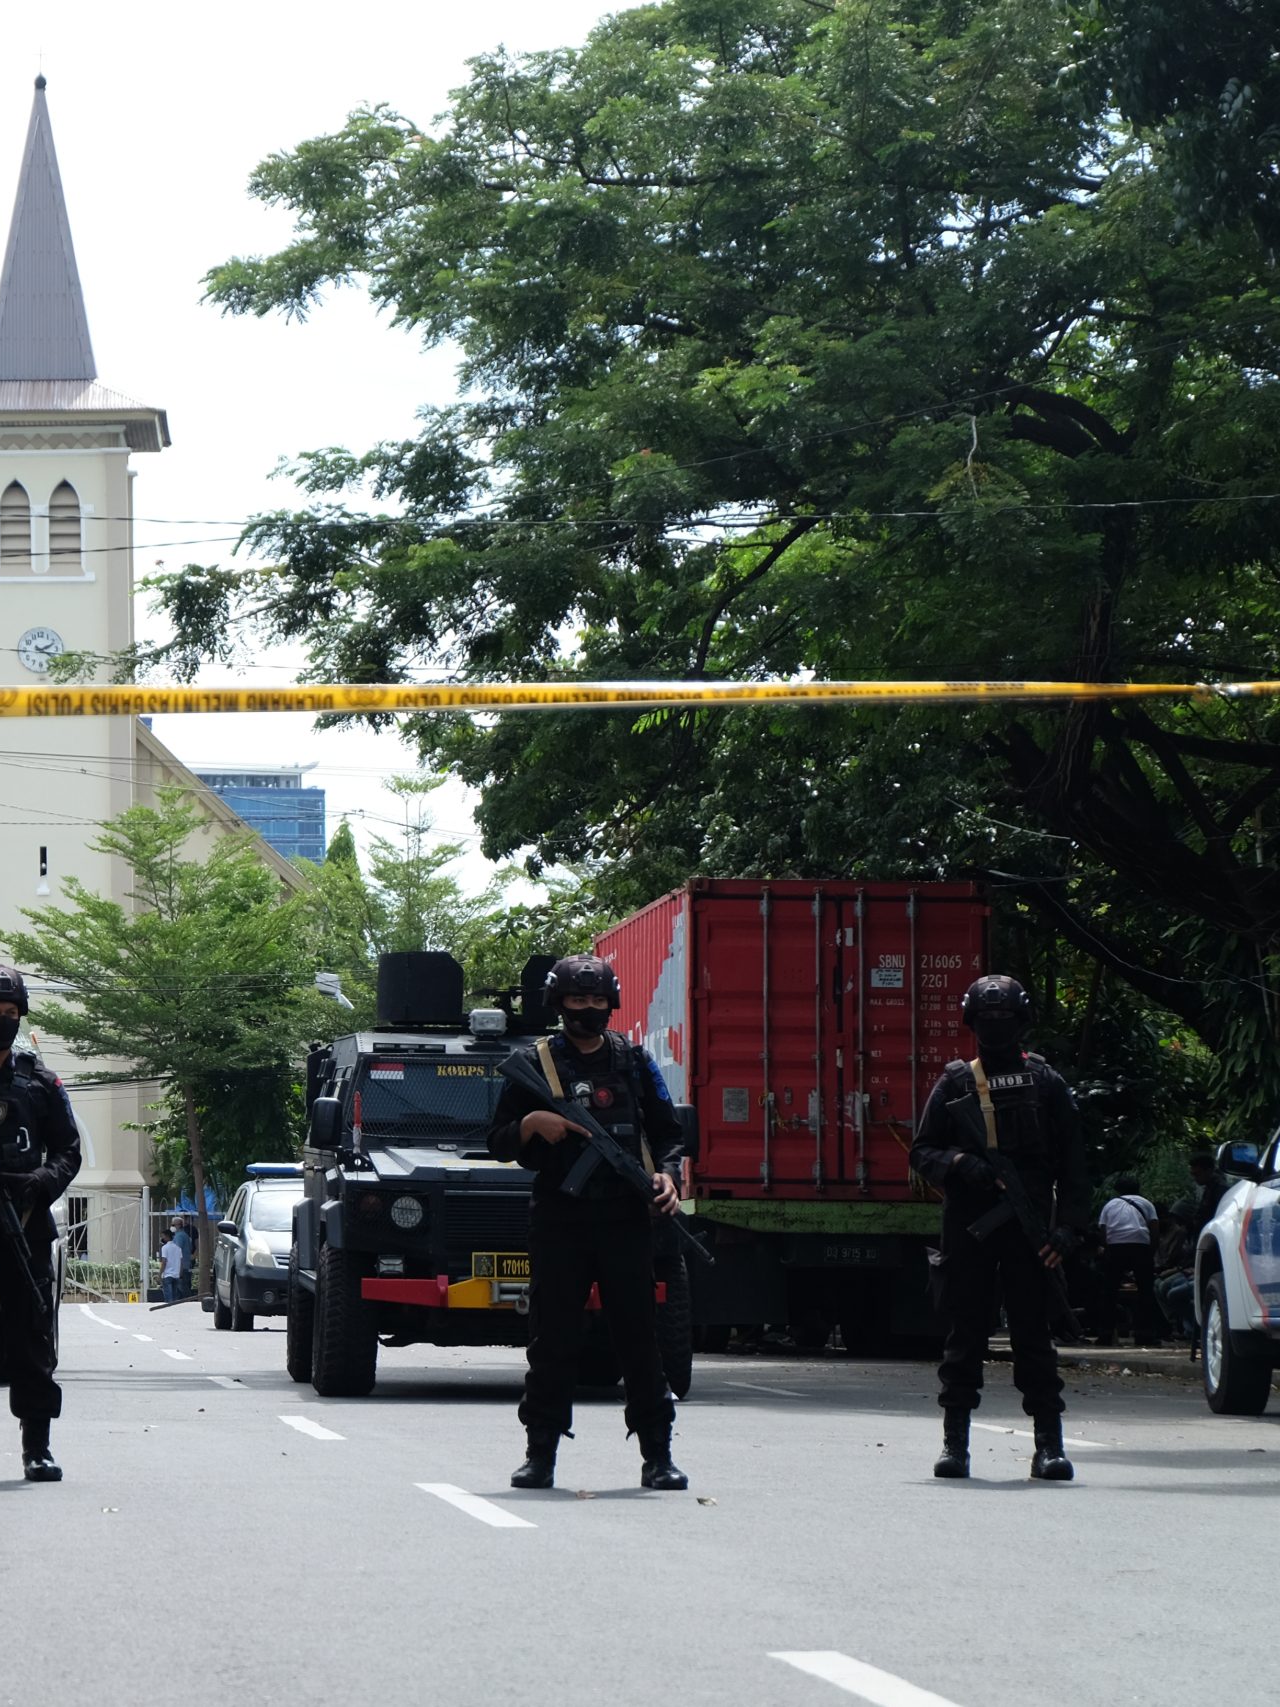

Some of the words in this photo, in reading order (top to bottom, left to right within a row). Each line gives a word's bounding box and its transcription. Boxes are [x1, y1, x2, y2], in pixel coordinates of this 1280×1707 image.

[27, 694, 84, 716] POLISI
[879, 954, 906, 969] SBNU
[921, 955, 962, 969] 216065
[972, 954, 980, 969] 4
[921, 974, 948, 988] 22G1
[437, 1065, 485, 1077] KORPS
